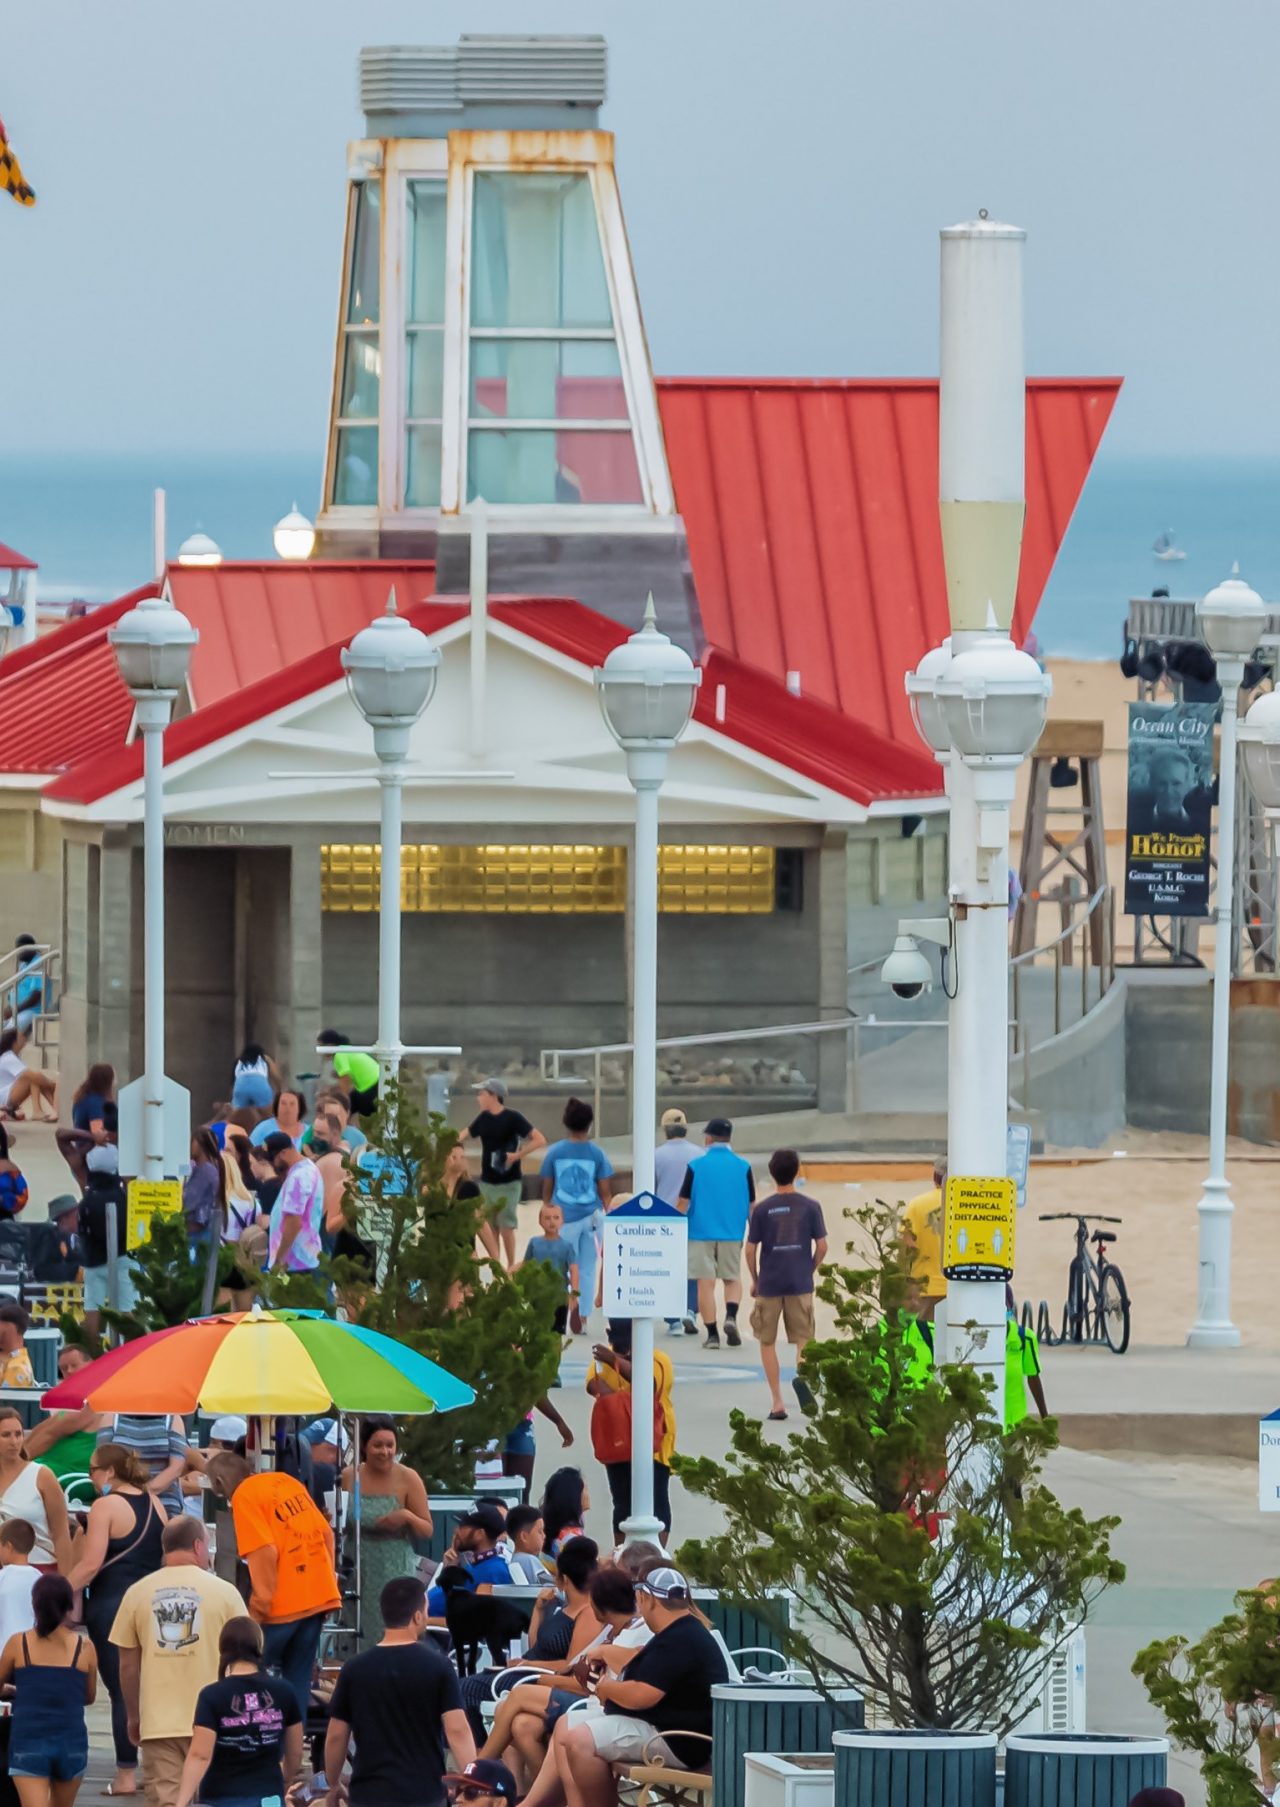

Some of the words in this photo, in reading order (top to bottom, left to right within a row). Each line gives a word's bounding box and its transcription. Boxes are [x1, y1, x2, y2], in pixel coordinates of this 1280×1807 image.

[1132, 717, 1175, 733] Ocean
[1179, 718, 1210, 738] City
[1151, 832, 1167, 842] We
[1131, 835, 1202, 857] Honor
[1165, 870, 1174, 881] T.
[960, 1190, 1003, 1199] PRACTICE
[959, 1202, 1001, 1210] PHYSICAL
[954, 1213, 1008, 1222] DISTANCING
[615, 1223, 657, 1236] Caroline
[660, 1224, 674, 1236] St.
[629, 1247, 663, 1257] Restroom
[629, 1267, 671, 1277] Information
[629, 1287, 655, 1295] Health
